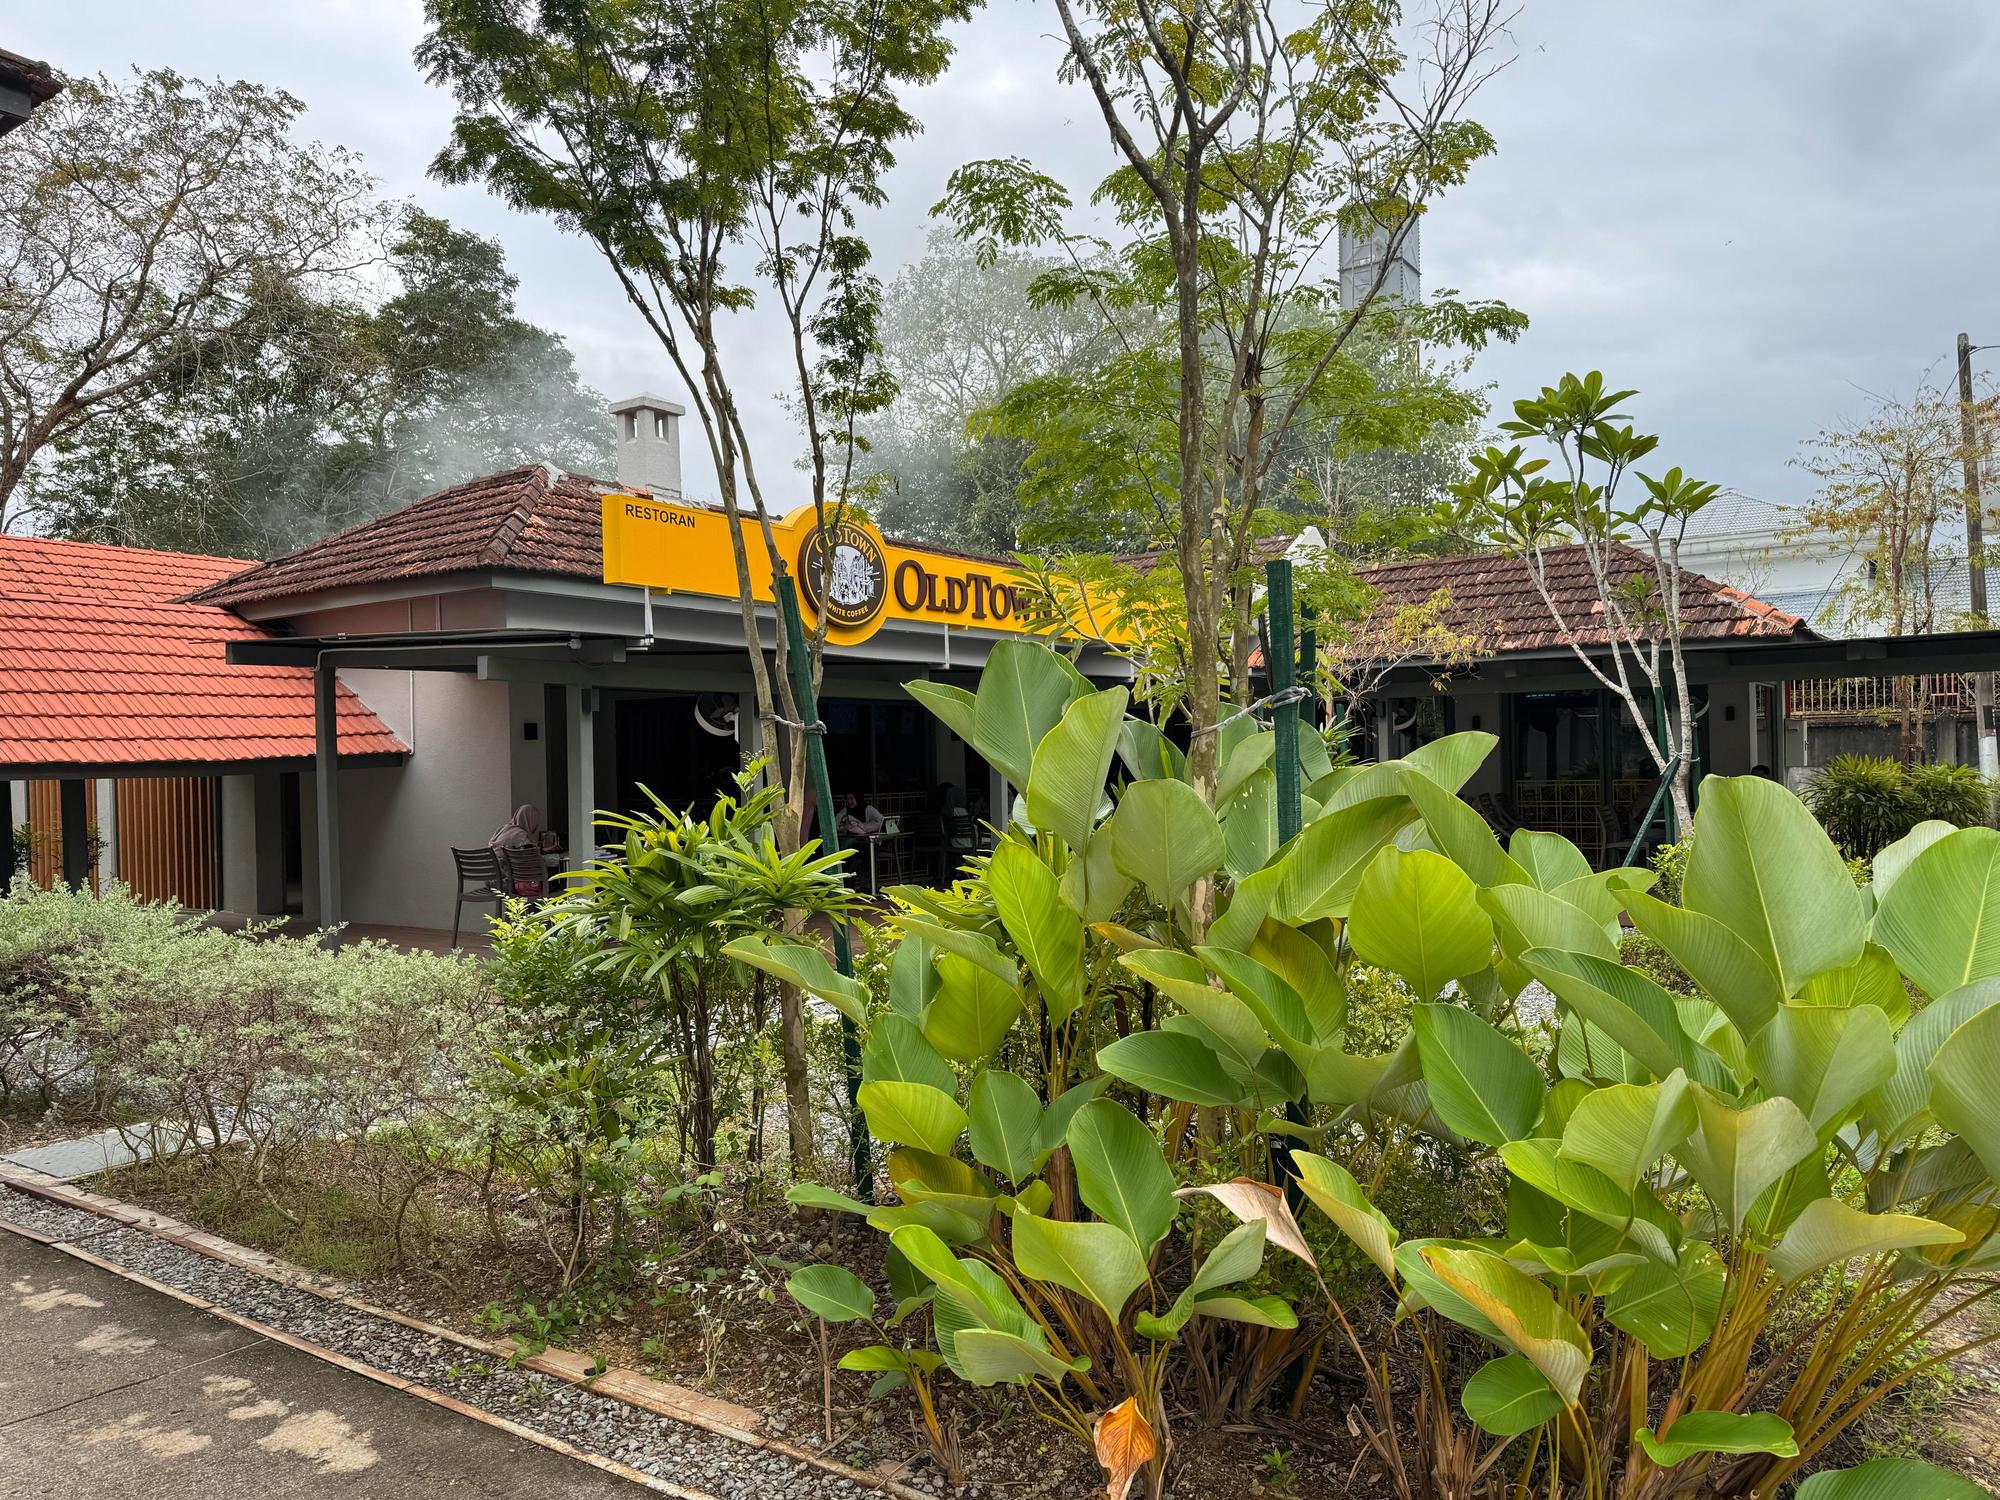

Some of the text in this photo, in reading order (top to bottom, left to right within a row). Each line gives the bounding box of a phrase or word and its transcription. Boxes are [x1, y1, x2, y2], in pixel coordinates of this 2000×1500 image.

[625, 503, 696, 528] RESTORAN
[827, 600, 869, 618] WHITE COFFEE
